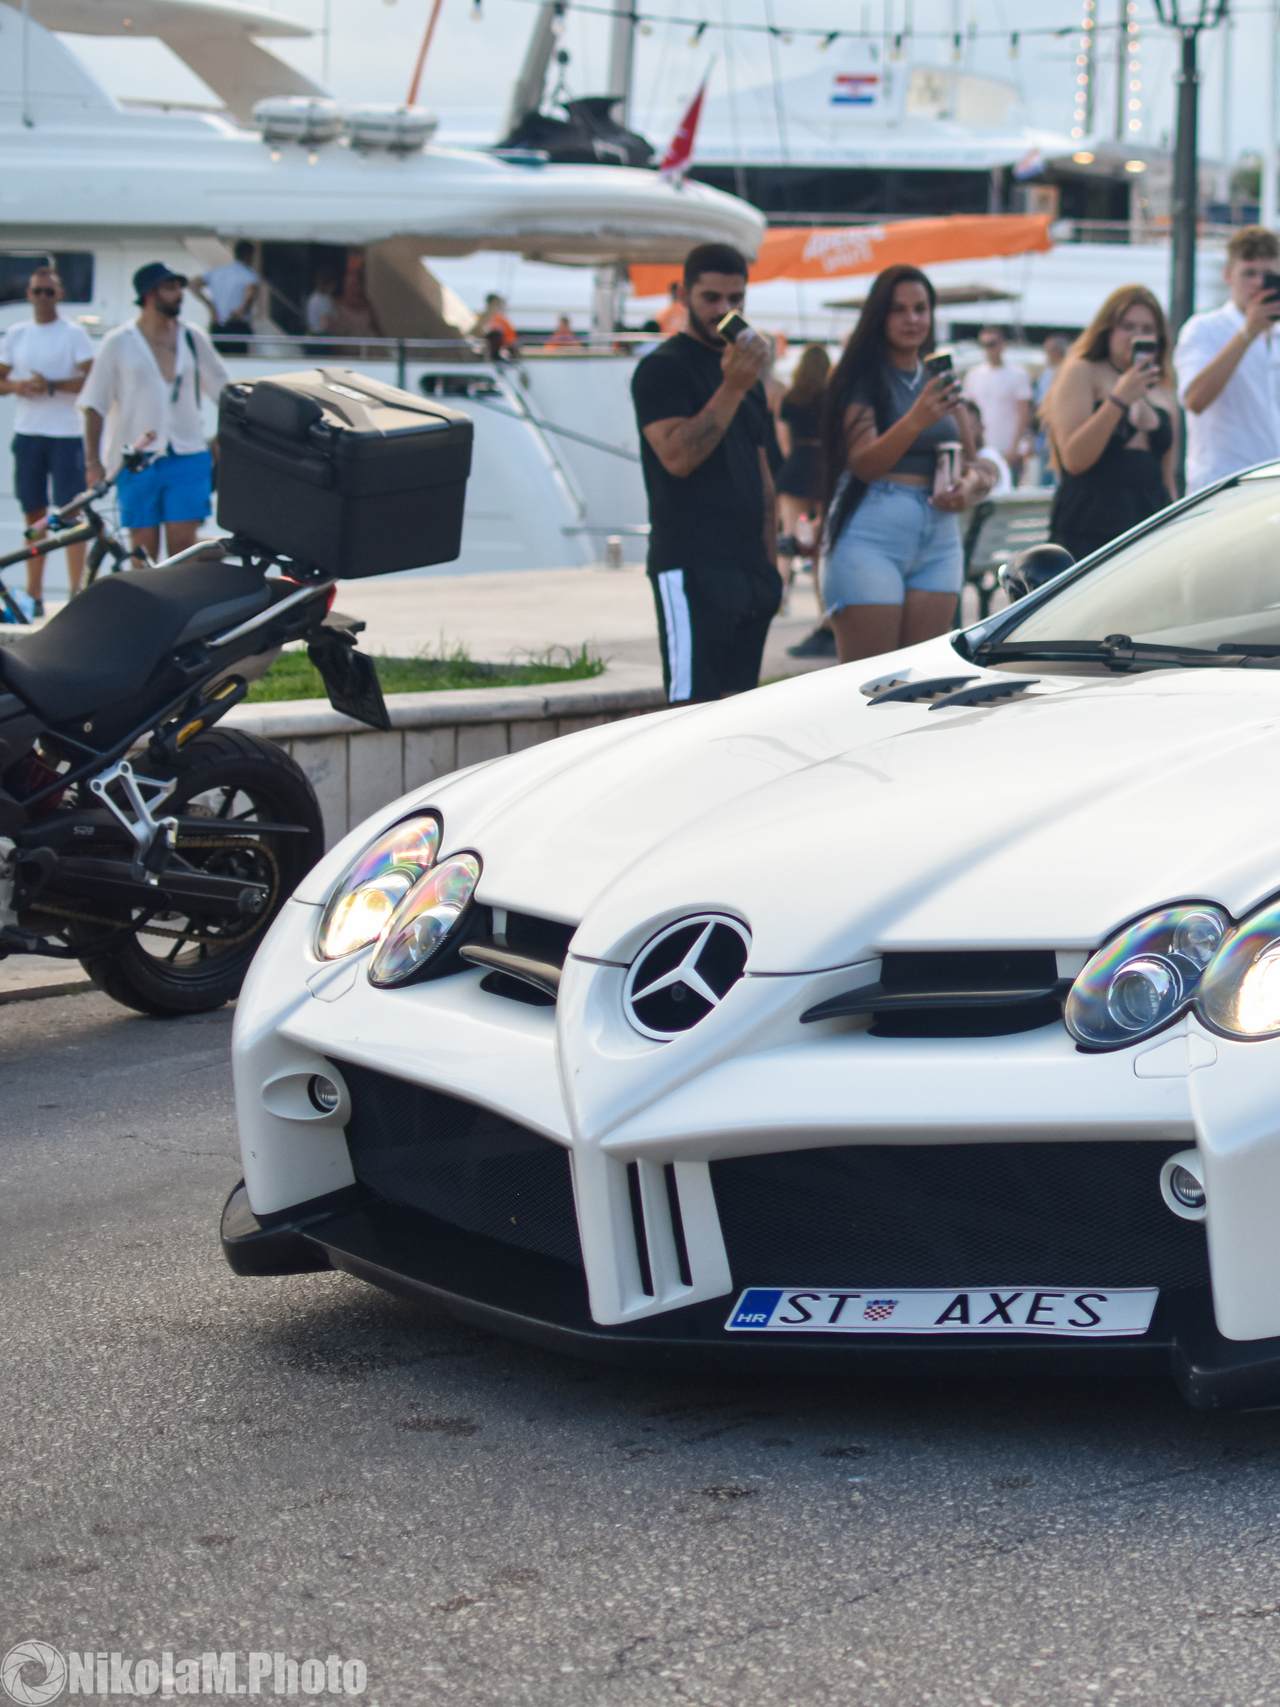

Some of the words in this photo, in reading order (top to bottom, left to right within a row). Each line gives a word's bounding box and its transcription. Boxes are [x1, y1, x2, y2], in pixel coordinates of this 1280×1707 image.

[737, 1313, 767, 1324] HR
[779, 1293, 861, 1325] ST
[934, 1292, 1108, 1328] AXES
